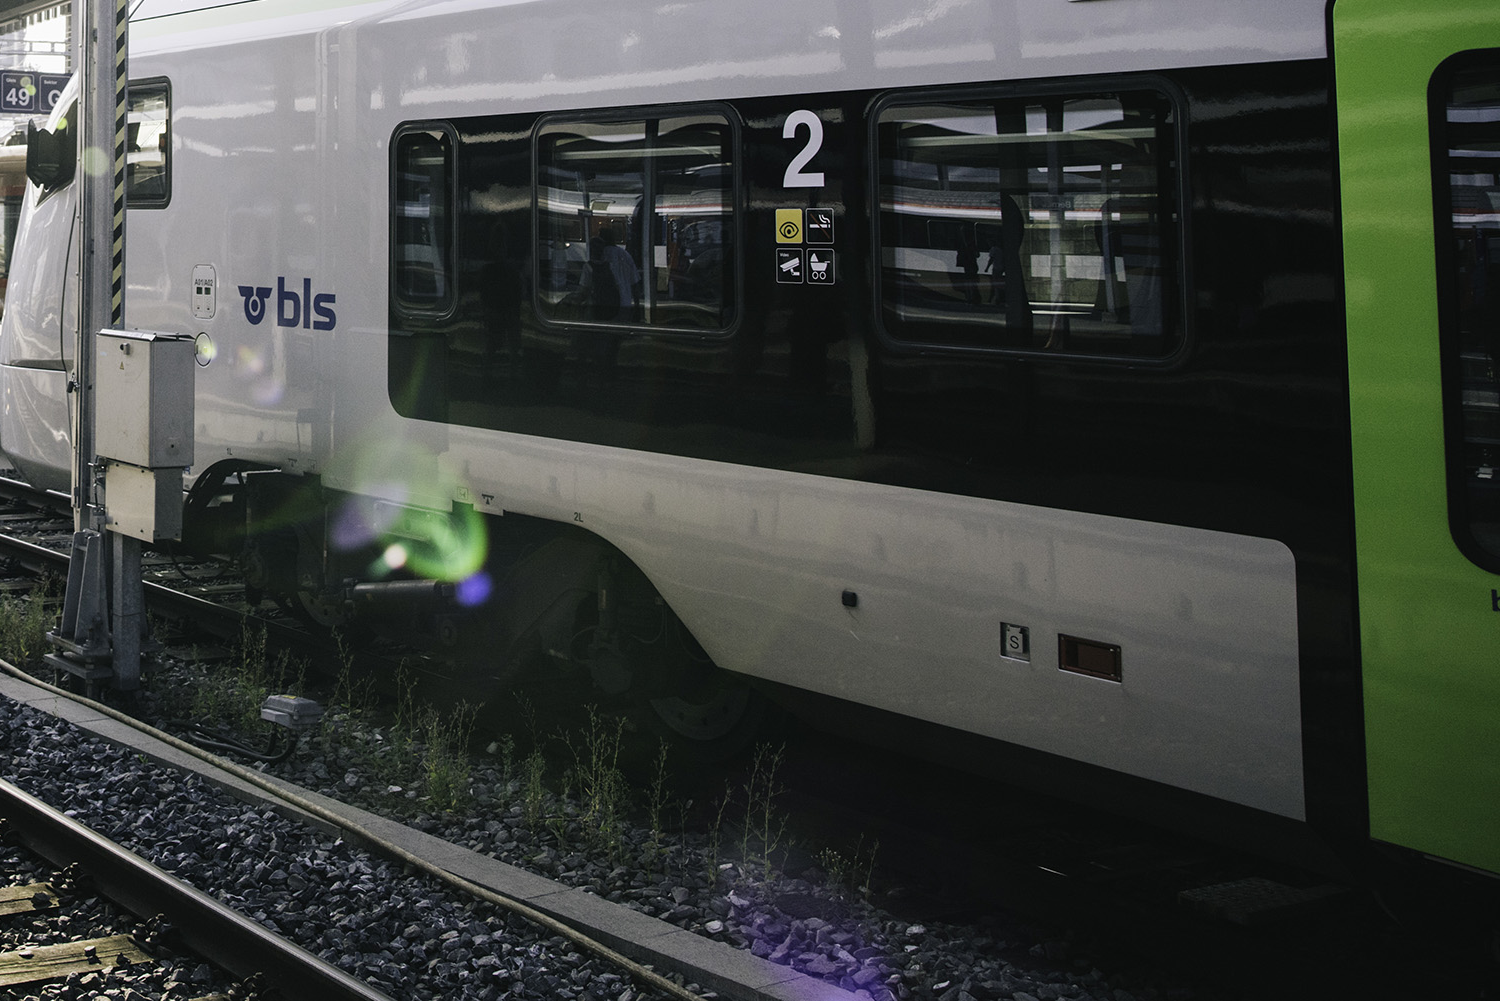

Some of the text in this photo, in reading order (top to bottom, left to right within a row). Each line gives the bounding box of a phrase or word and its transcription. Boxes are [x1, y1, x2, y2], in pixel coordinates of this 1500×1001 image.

[5, 87, 30, 106] 49
[48, 89, 62, 107] G
[782, 109, 825, 188] 2
[277, 276, 337, 331] bls
[573, 511, 584, 523] 2L
[1009, 635, 1020, 650] S
